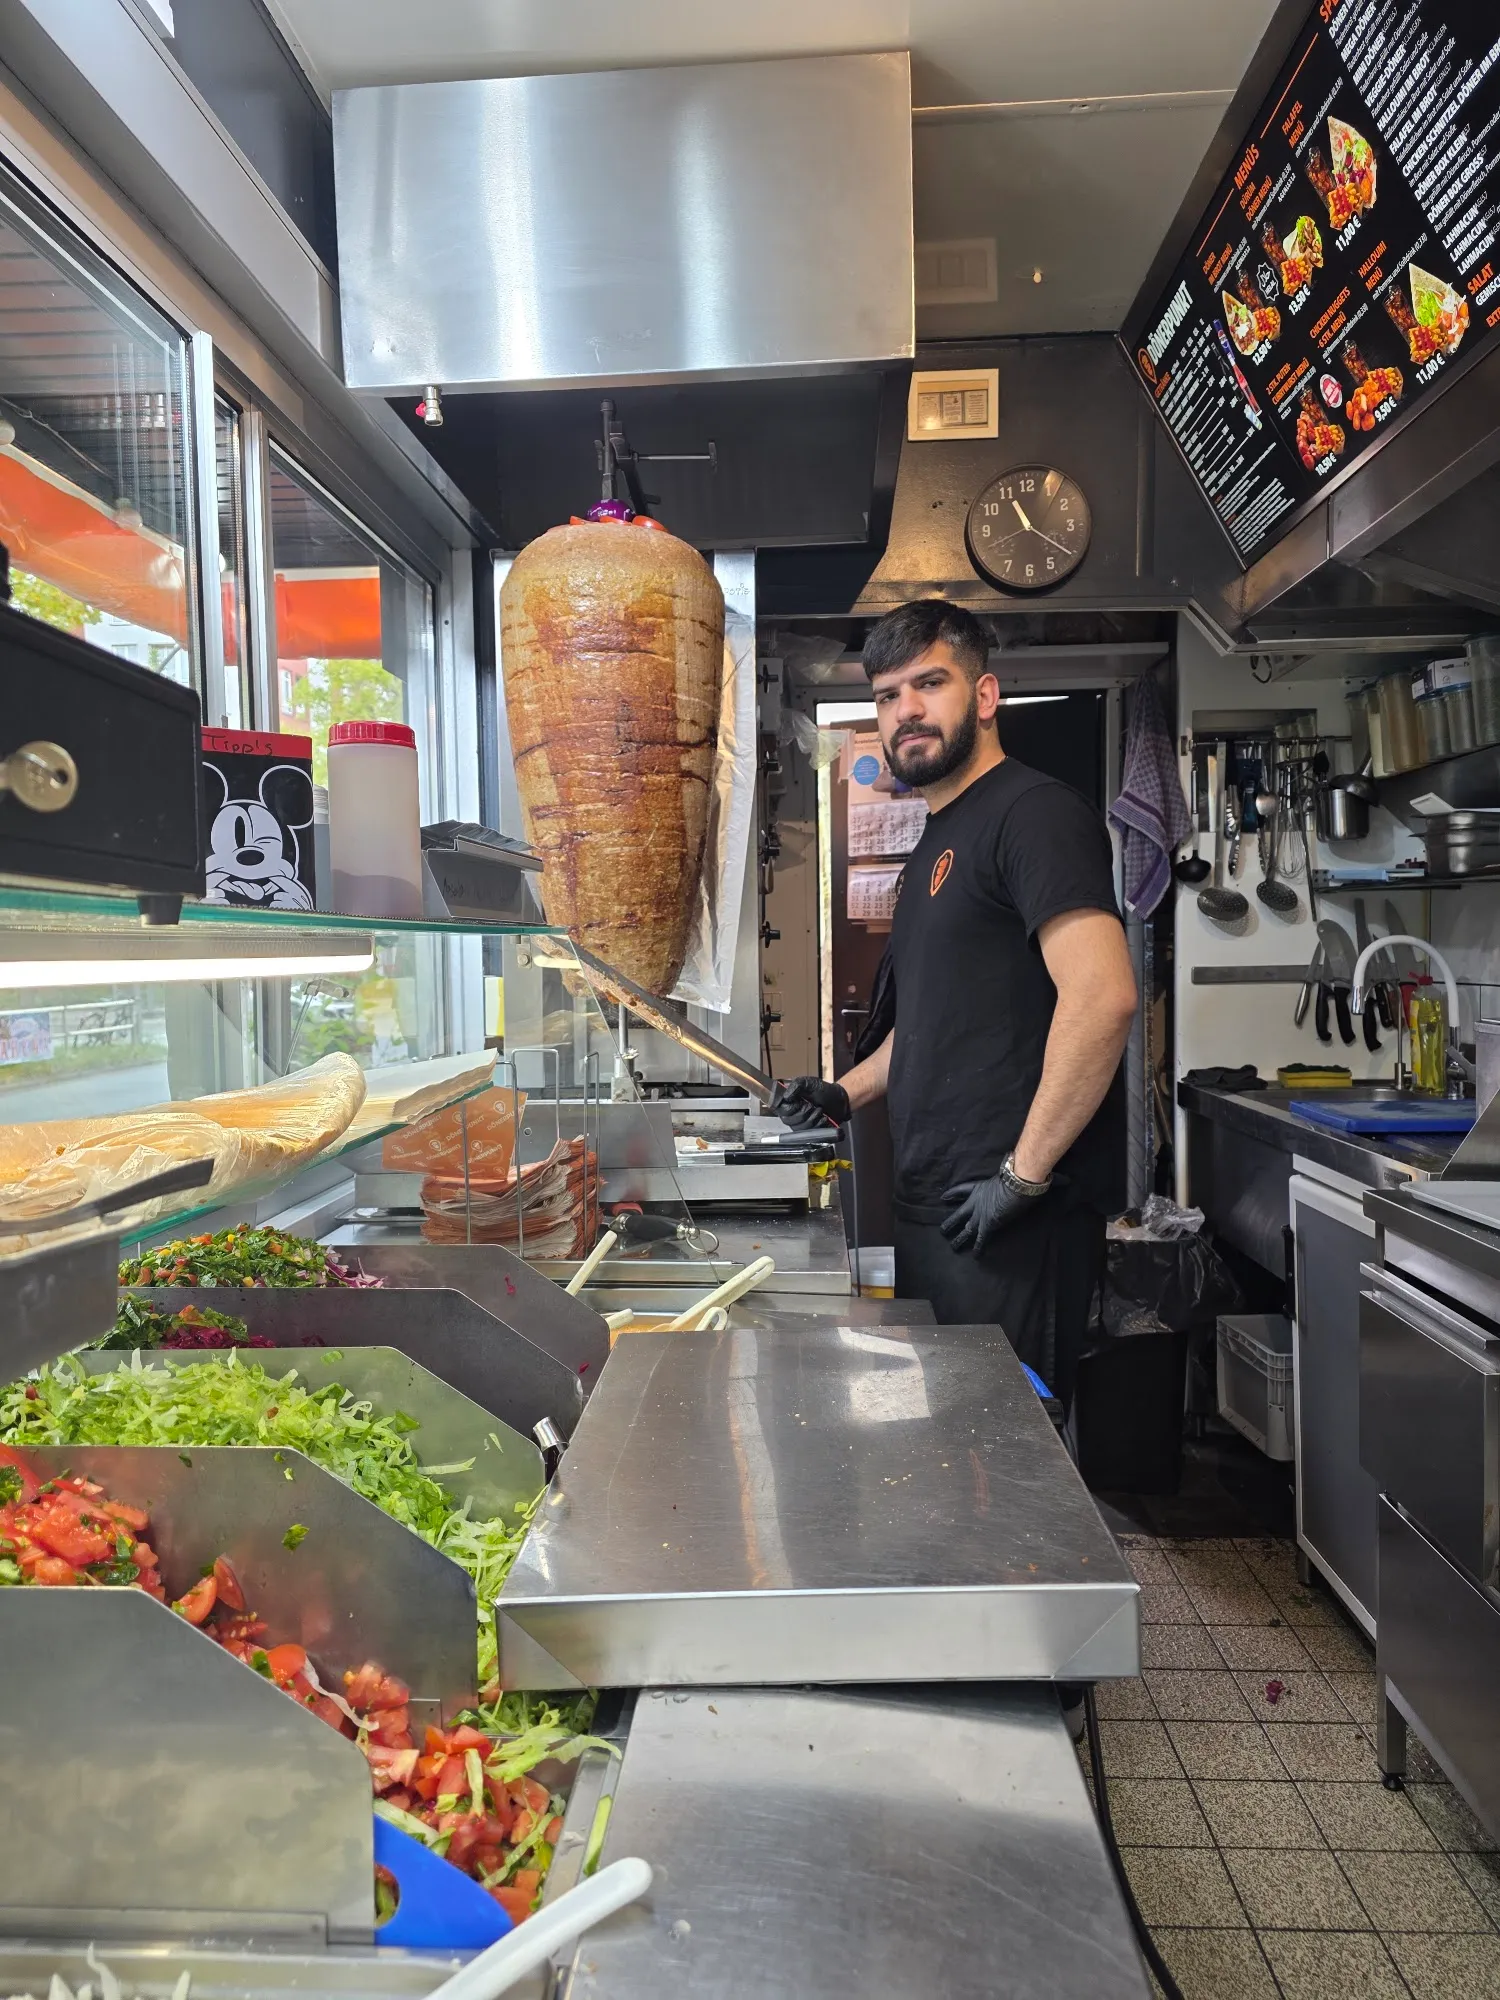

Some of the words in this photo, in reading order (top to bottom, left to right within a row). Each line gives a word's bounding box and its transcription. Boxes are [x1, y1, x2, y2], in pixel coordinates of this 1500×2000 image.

[1329, 4, 1349, 39] DÖNER
[1341, 33, 1359, 63] MEGA
[1355, 1, 1376, 37] DÖNER
[1347, 40, 1366, 72] Fladenbrot
[1365, 22, 1377, 46] gefüllt
[1353, 60, 1367, 86] MINI
[1364, 31, 1386, 67] DÖNER
[1359, 64, 1379, 95] Fladenbrot
[1377, 47, 1389, 70] gefüllt
[1387, 37, 1396, 51] mit
[1364, 44, 1406, 108] VEGGIE-DÖNER
[1371, 88, 1391, 119] Fladenbrot
[1390, 71, 1402, 94] gefüllt
[1400, 57, 1411, 75] Salat
[1410, 44, 1419, 61] und
[1416, 32, 1428, 50] Soße
[1411, 87, 1421, 102] Brot
[1419, 77, 1428, 91] mit
[1425, 63, 1437, 82] Salat
[1436, 50, 1447, 67] und
[1443, 37, 1455, 55] Soße
[1377, 86, 1407, 132] HALLOUMI
[1404, 74, 1415, 92] IM
[1412, 51, 1430, 80] BROT
[1426, 107, 1437, 123] Brot
[1435, 98, 1444, 112] mit
[1441, 84, 1455, 102] Salat
[1453, 71, 1462, 88] und
[1460, 58, 1473, 76] Soße
[1282, 101, 1303, 135] FALAFEL
[1289, 120, 1304, 148] MENÜ
[1299, 127, 1314, 150] Pommes
[1312, 115, 1320, 130] und
[1317, 93, 1333, 120] Softdrink
[1389, 119, 1415, 155] FALAFEL
[1411, 107, 1423, 124] IM
[1419, 84, 1438, 113] BROT
[1402, 140, 1429, 177] CHICKEN
[1426, 100, 1461, 147] SCHNITZEL
[1456, 68, 1484, 105] DÖNER
[1479, 56, 1492, 74] IM
[1234, 144, 1259, 190] MENÜS
[1413, 167, 1423, 181] Brot
[1421, 159, 1429, 171] mit
[1427, 146, 1439, 163] Salat
[1438, 135, 1447, 151] und
[1445, 124, 1457, 141] Soße
[1414, 170, 1437, 201] DÖNER
[1434, 154, 1450, 177] BOX
[1446, 131, 1468, 160] KLEIN
[1421, 199, 1430, 210] Box
[1428, 183, 1442, 204] gefüllt
[1440, 175, 1449, 188] mit
[1446, 146, 1473, 179] Dönerfleisch,
[1471, 123, 1491, 148] Pommes
[1489, 111, 1500, 127] oder
[1240, 182, 1256, 209] DÜRÜM
[1246, 195, 1261, 221] DÖNER
[1258, 176, 1272, 200] MENÜ
[1427, 193, 1451, 224] DÖNER
[1447, 177, 1464, 200] BOX
[1460, 152, 1484, 183] GROSS
[1434, 222, 1443, 233] Box
[1441, 207, 1455, 227] gefüllt
[1453, 199, 1462, 211] mit
[1459, 171, 1487, 203] Dönerfleisch,
[1335, 222, 1356, 251] 11,00
[1353, 215, 1361, 228] €
[1442, 205, 1479, 249] LAHMACUN
[1450, 218, 1487, 262] LAHMACUN
[1203, 252, 1216, 274] DÖNER
[1358, 241, 1387, 278] HALLOUMI
[1457, 232, 1495, 275] LAHMACUN
[1365, 266, 1383, 291] MENÜ
[1372, 290, 1380, 300] mit
[1377, 274, 1393, 294] Pommes
[1392, 264, 1401, 278] und
[1398, 247, 1417, 269] Softdrink
[1467, 263, 1493, 295] SALAT
[1288, 290, 1306, 315] 13,50
[1303, 284, 1310, 296] €
[1310, 312, 1330, 338] CHICKEN
[1327, 286, 1350, 317] NUGGETS
[1147, 280, 1193, 366] DÖNERPUNKT
[1321, 329, 1334, 344] STK.
[1330, 311, 1346, 333] MENÜ
[1252, 344, 1268, 366] 12,50
[1265, 338, 1272, 349] €
[1318, 339, 1325, 348] 6
[1416, 359, 1439, 384] 11,00
[1436, 353, 1445, 365] €
[1374, 401, 1391, 422] 9,50
[1389, 396, 1397, 408] €
[1315, 456, 1332, 476] 10,50
[1329, 452, 1337, 463] €
[1000, 487, 1013, 499] 11
[1020, 480, 1035, 492] 12
[1046, 484, 1051, 496] 1
[1060, 498, 1068, 510] 2
[984, 503, 999, 516] 10
[1067, 519, 1074, 531] 3
[982, 525, 990, 537] 9
[1004, 560, 1012, 572] 7
[1026, 564, 1033, 576] 6
[1047, 557, 1054, 569] 5
